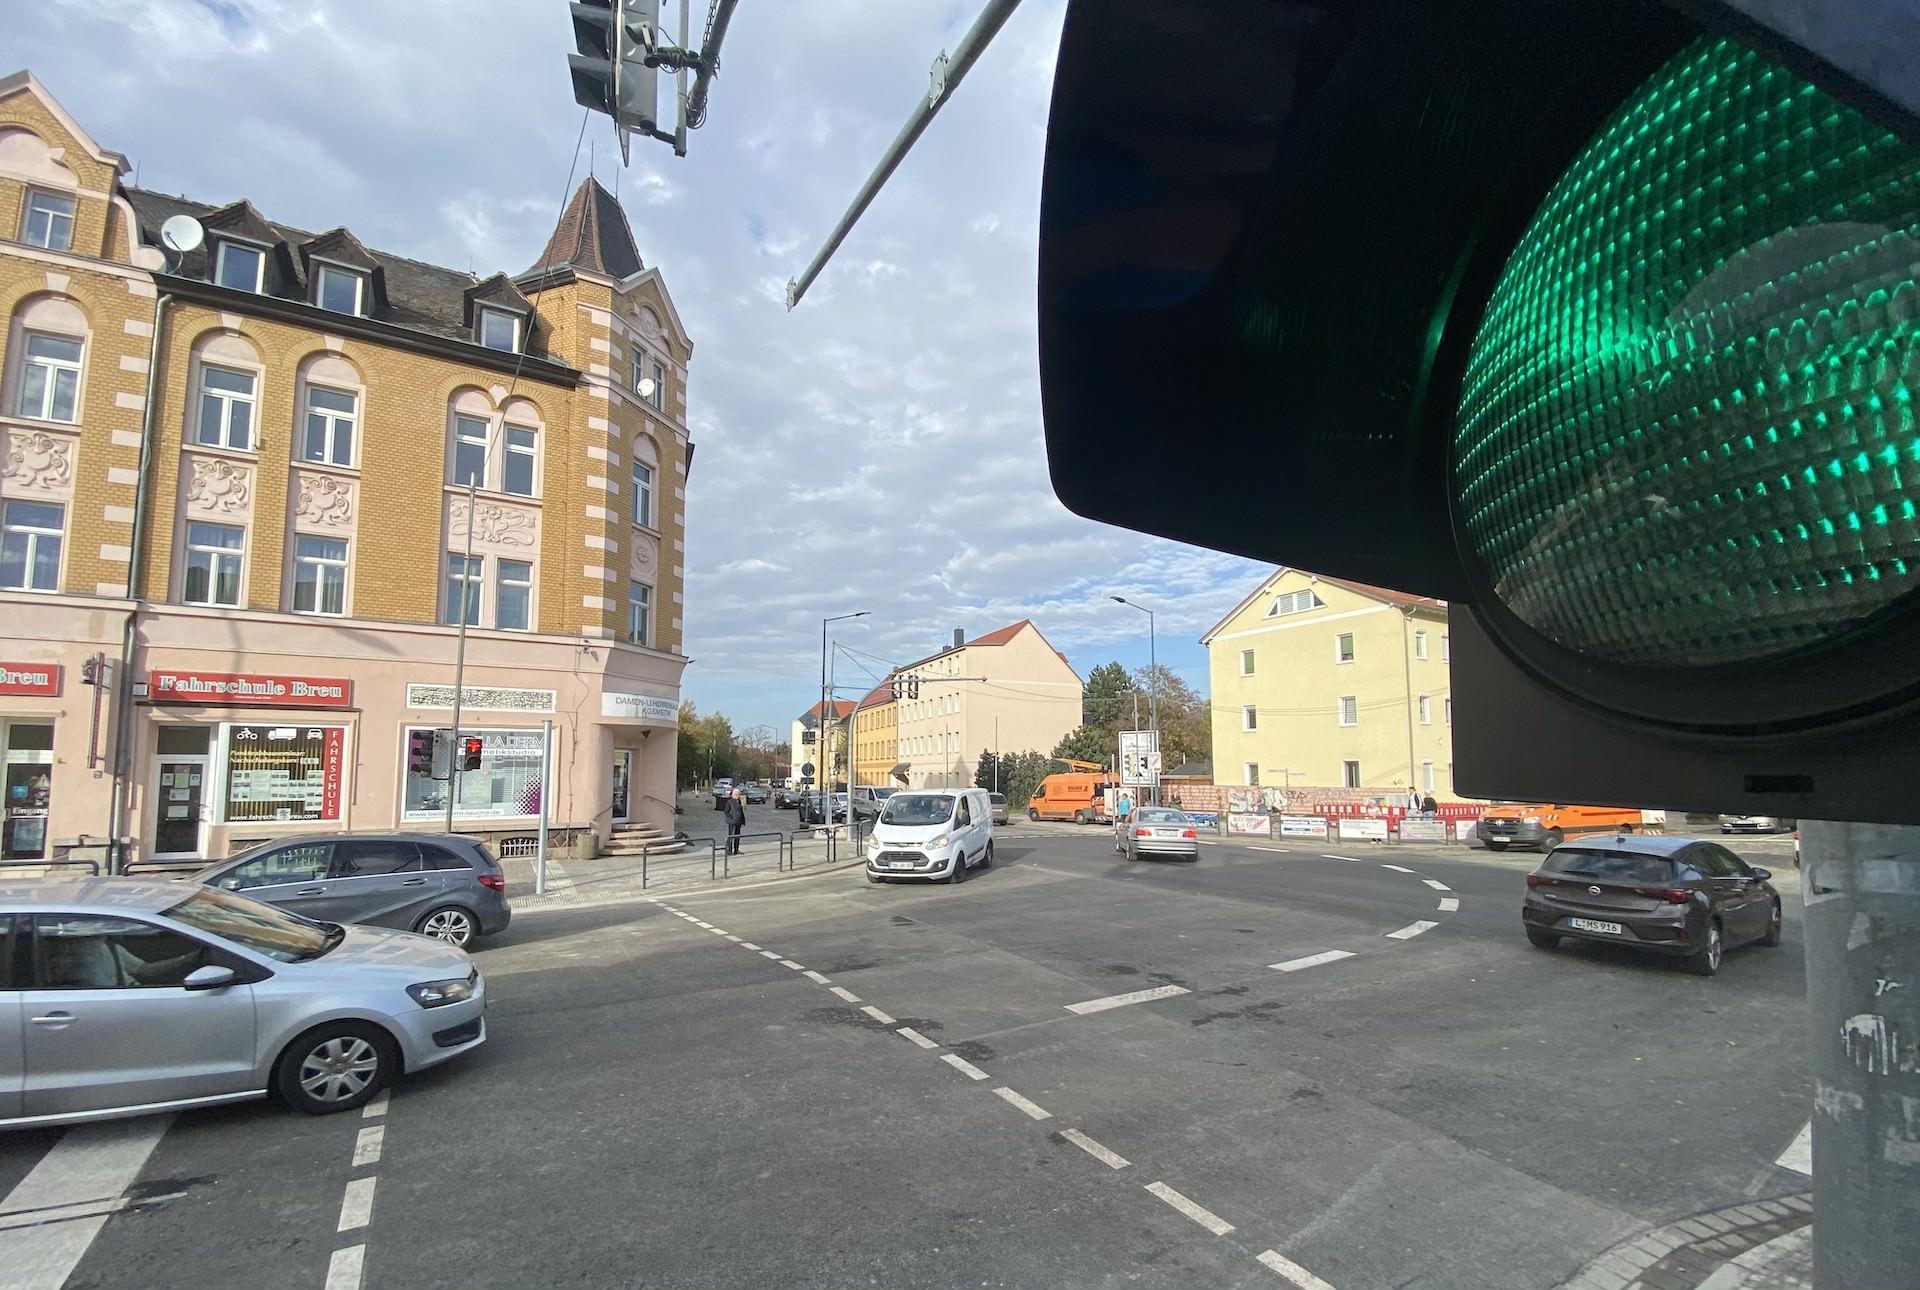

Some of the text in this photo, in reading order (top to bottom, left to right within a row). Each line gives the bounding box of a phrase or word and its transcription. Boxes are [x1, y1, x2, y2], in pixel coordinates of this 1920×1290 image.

[158, 675, 342, 698] Fahrschule Breu
[327, 730, 339, 816] FAHRSCHULE
[13, 807, 49, 816] Eingang
